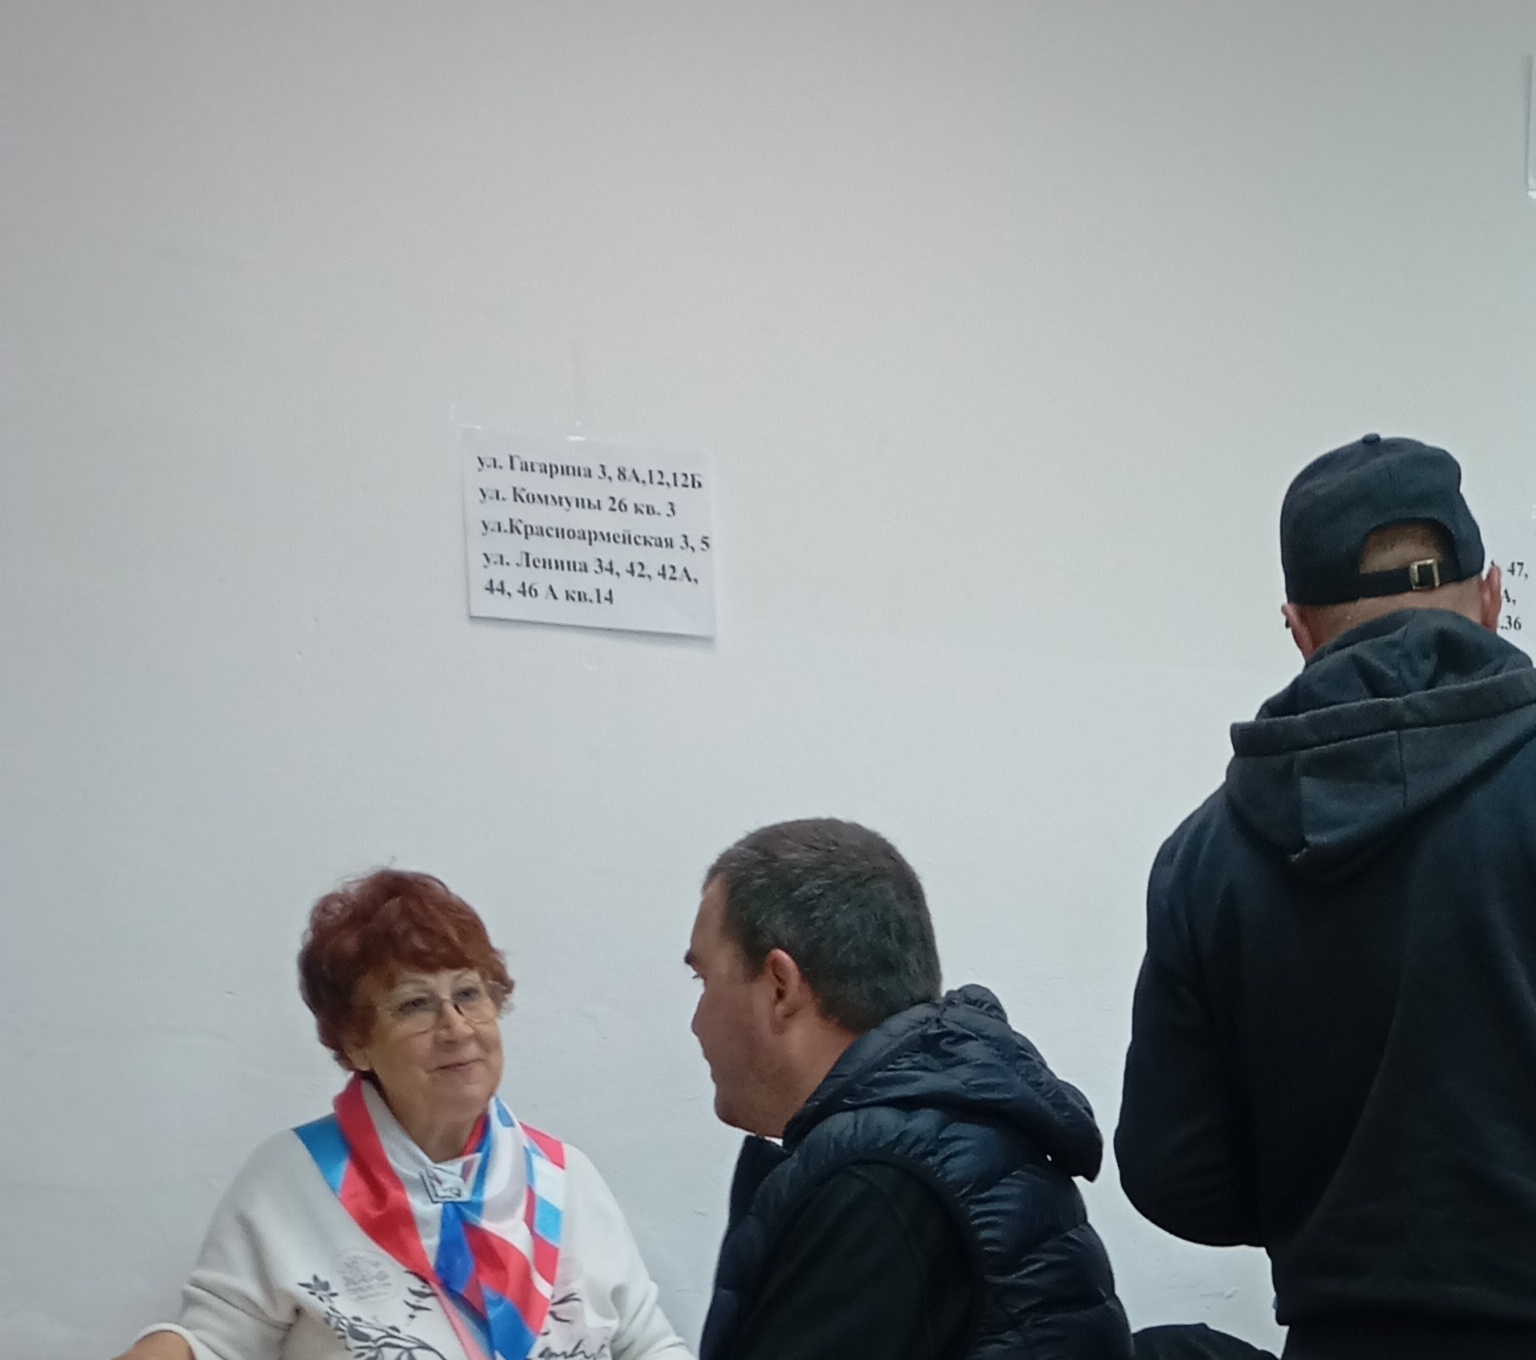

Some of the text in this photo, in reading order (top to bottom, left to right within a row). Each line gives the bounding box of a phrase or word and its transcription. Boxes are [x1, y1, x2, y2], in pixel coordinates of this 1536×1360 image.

[477, 454, 703, 490] ул. Гагарина 3, 8А,12,12Б
[478, 486, 676, 518] ул. Коммуны 26 кв. 3
[480, 518, 710, 553] ул.Красноармейская 3, 5
[482, 551, 698, 585] ул. Ленина 34, 42, 42А,
[1507, 561, 1528, 580] 47,
[485, 579, 615, 605] 44, 46 А кв.14
[1500, 615, 1522, 630] .36
